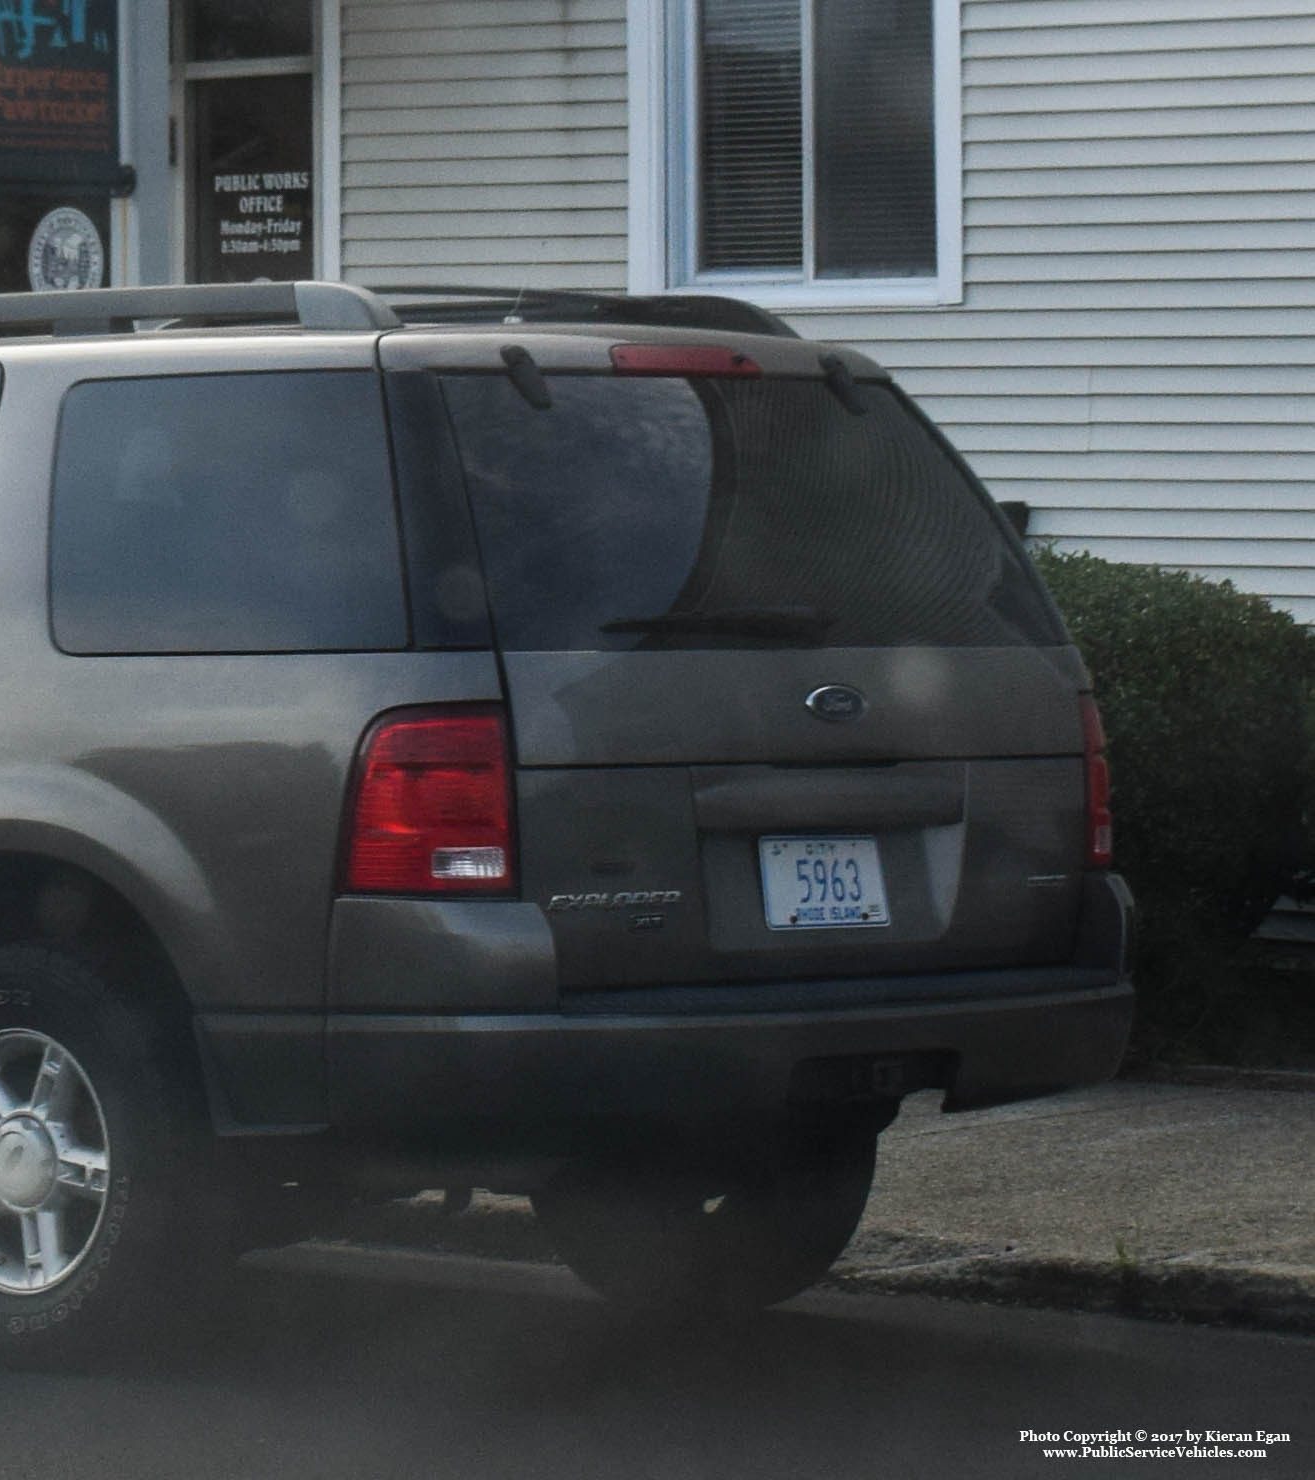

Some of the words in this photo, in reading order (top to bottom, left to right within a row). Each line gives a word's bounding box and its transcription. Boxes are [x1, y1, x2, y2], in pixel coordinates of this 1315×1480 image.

[214, 174, 261, 192] PUBLIC
[262, 172, 309, 190] WORKS
[239, 195, 284, 213] OFFICE
[220, 218, 301, 236] Monday-Friday
[795, 858, 863, 904] 5963
